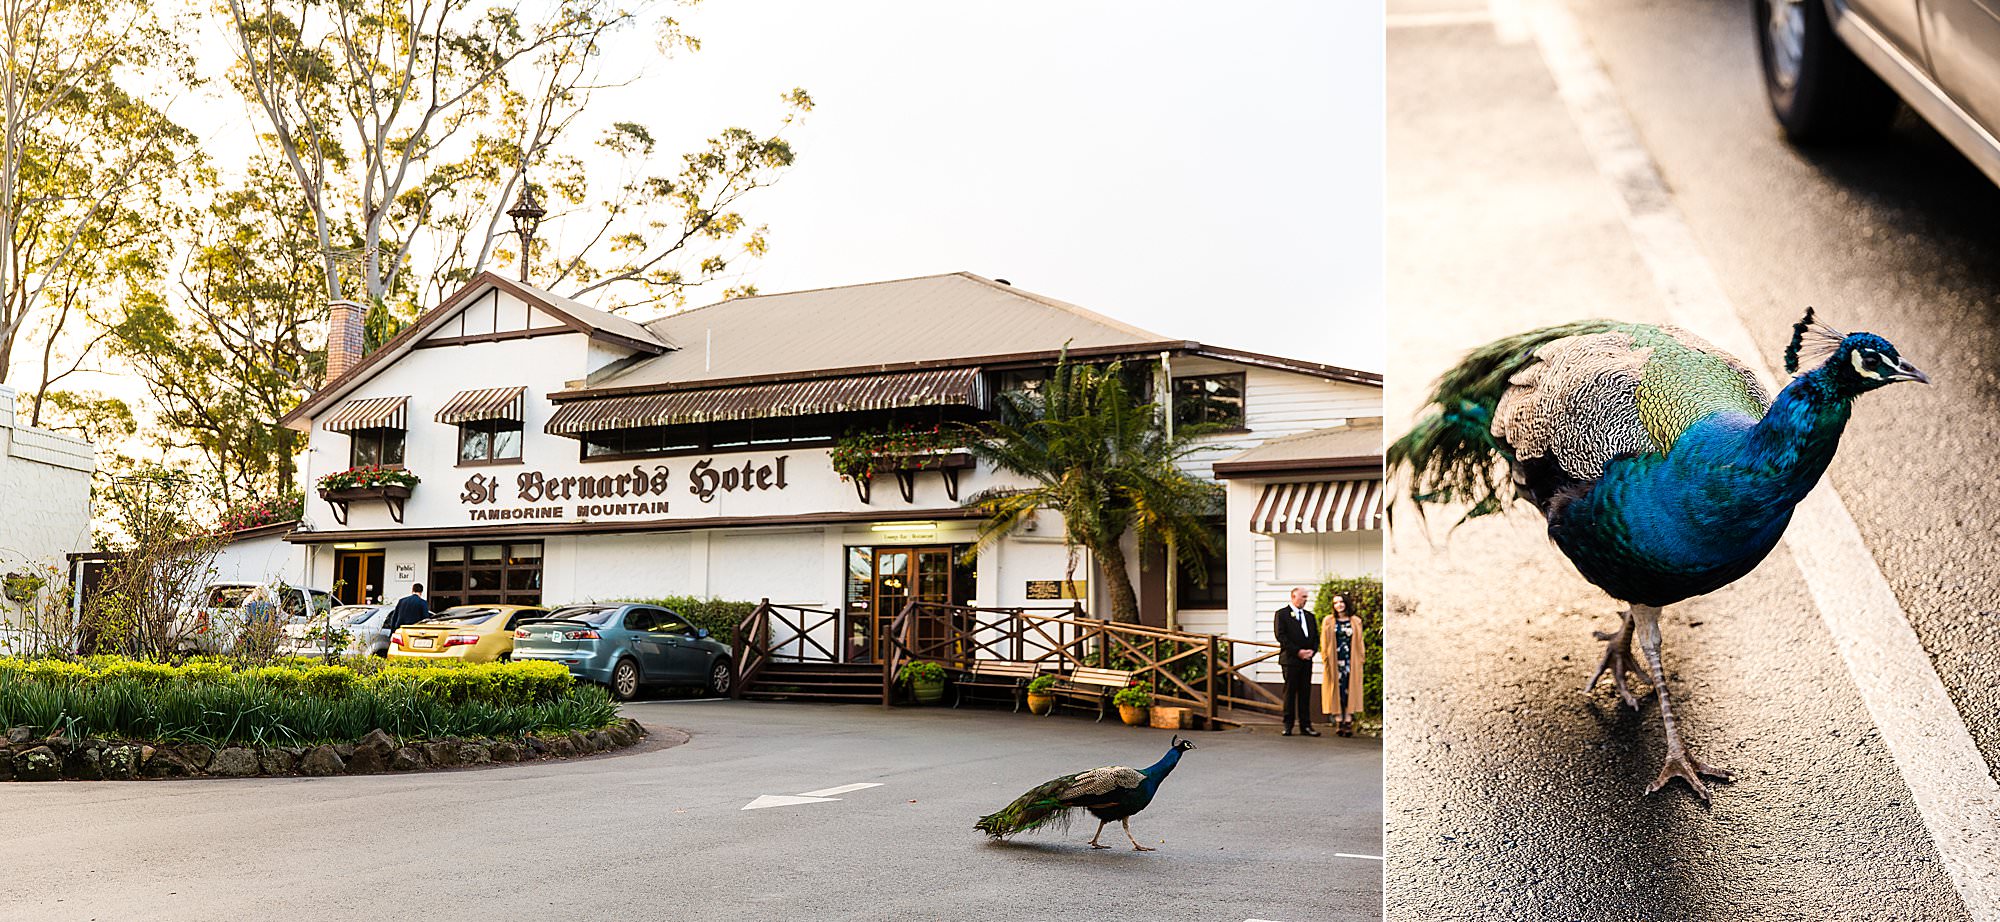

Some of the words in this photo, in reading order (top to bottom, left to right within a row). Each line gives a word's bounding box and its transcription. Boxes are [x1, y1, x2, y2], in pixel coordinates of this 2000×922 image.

[460, 473, 499, 504] St
[517, 465, 670, 503] Bernards
[690, 455, 789, 503] Hotel
[469, 506, 563, 520] TAMBORINE
[576, 501, 669, 517] MOUNTAIN
